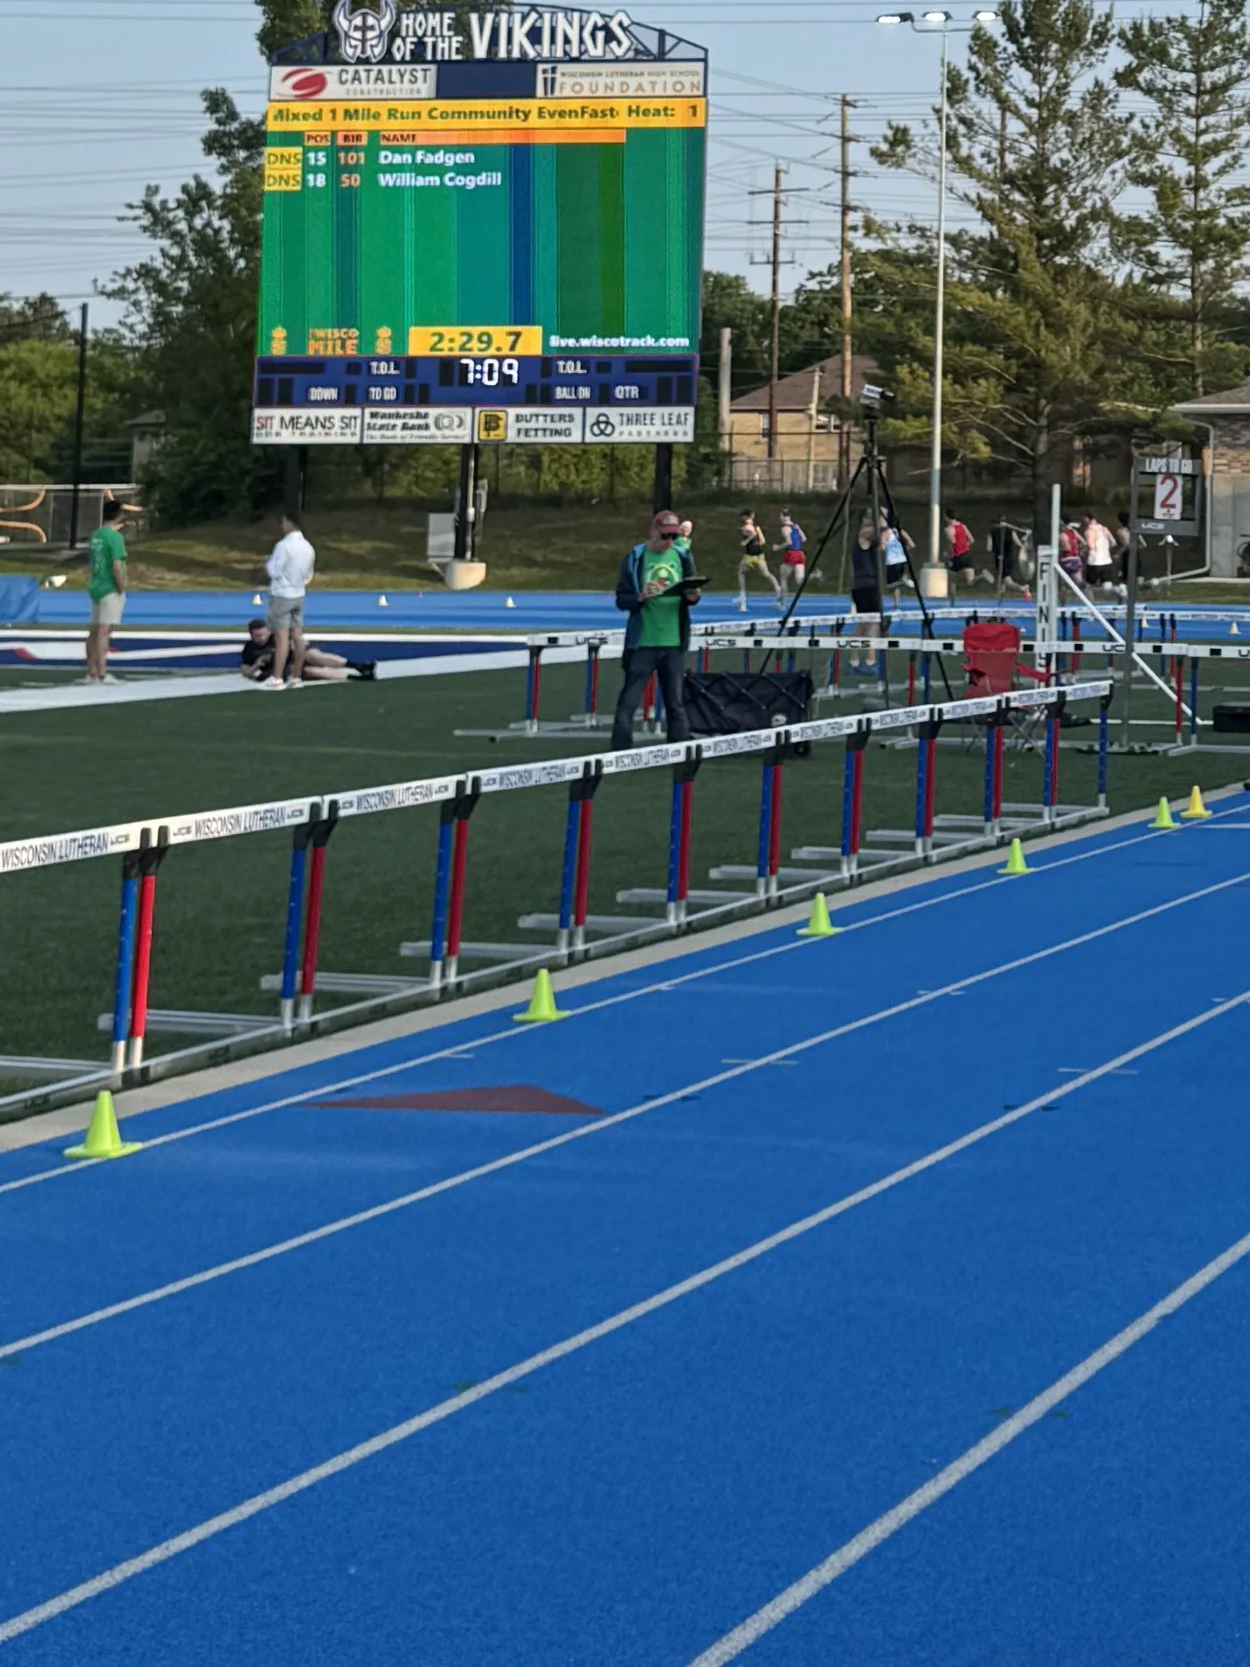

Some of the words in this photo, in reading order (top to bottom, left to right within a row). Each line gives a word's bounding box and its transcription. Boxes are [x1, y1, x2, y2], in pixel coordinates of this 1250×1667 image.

[402, 13, 456, 35] HOME
[469, 10, 636, 60] VIKINGS
[391, 37, 415, 61] OF
[418, 36, 464, 61] THE
[338, 67, 432, 86] CATALYST
[559, 80, 701, 94] FOUNDATION
[330, 108, 337, 121] 1
[344, 108, 381, 121] Mile
[388, 108, 422, 120] Run
[428, 106, 532, 122] Community
[627, 105, 676, 118] Heat:
[689, 105, 698, 116] 1
[267, 153, 302, 165] DNS
[307, 151, 327, 165] 15
[338, 152, 365, 165] 101
[379, 150, 412, 164] Dan
[416, 150, 475, 166] Fadgen
[267, 174, 301, 186] DNS
[307, 173, 326, 187] 18
[378, 173, 440, 186] William
[443, 172, 502, 189] Cogdill
[308, 339, 360, 355] MILE
[429, 331, 523, 352] 2:29.7
[549, 335, 690, 348] live.wiscotrack.com
[460, 358, 519, 386] 7:09
[309, 386, 338, 401] DOWN
[369, 386, 382, 400] TO
[384, 387, 397, 400] GO
[555, 386, 577, 399] BALL
[578, 387, 591, 399] ON
[614, 385, 640, 399] QTR
[256, 416, 274, 430] SIT
[280, 415, 336, 430] MEANS
[339, 415, 360, 430] SIT
[515, 413, 575, 424] BUTTERS
[619, 412, 656, 426] THREE
[661, 412, 690, 425] LEAF
[401, 422, 431, 431] Bank
[516, 427, 573, 438] FETTING
[1145, 458, 1168, 473] LAPS
[1169, 458, 1180, 473] TO
[1181, 459, 1193, 474] GO
[1160, 473, 1179, 509] 2
[576, 635, 608, 646] UCS
[704, 638, 737, 648] UCS
[837, 639, 871, 649] UCS
[356, 790, 397, 812] WISCONSIN
[396, 784, 434, 806] LUTHERAN
[195, 814, 243, 838] WISCONSIN
[243, 805, 287, 833] LUTHERAN
[1, 842, 58, 870] WISCONSIN
[57, 832, 109, 861] LUTHERAN
